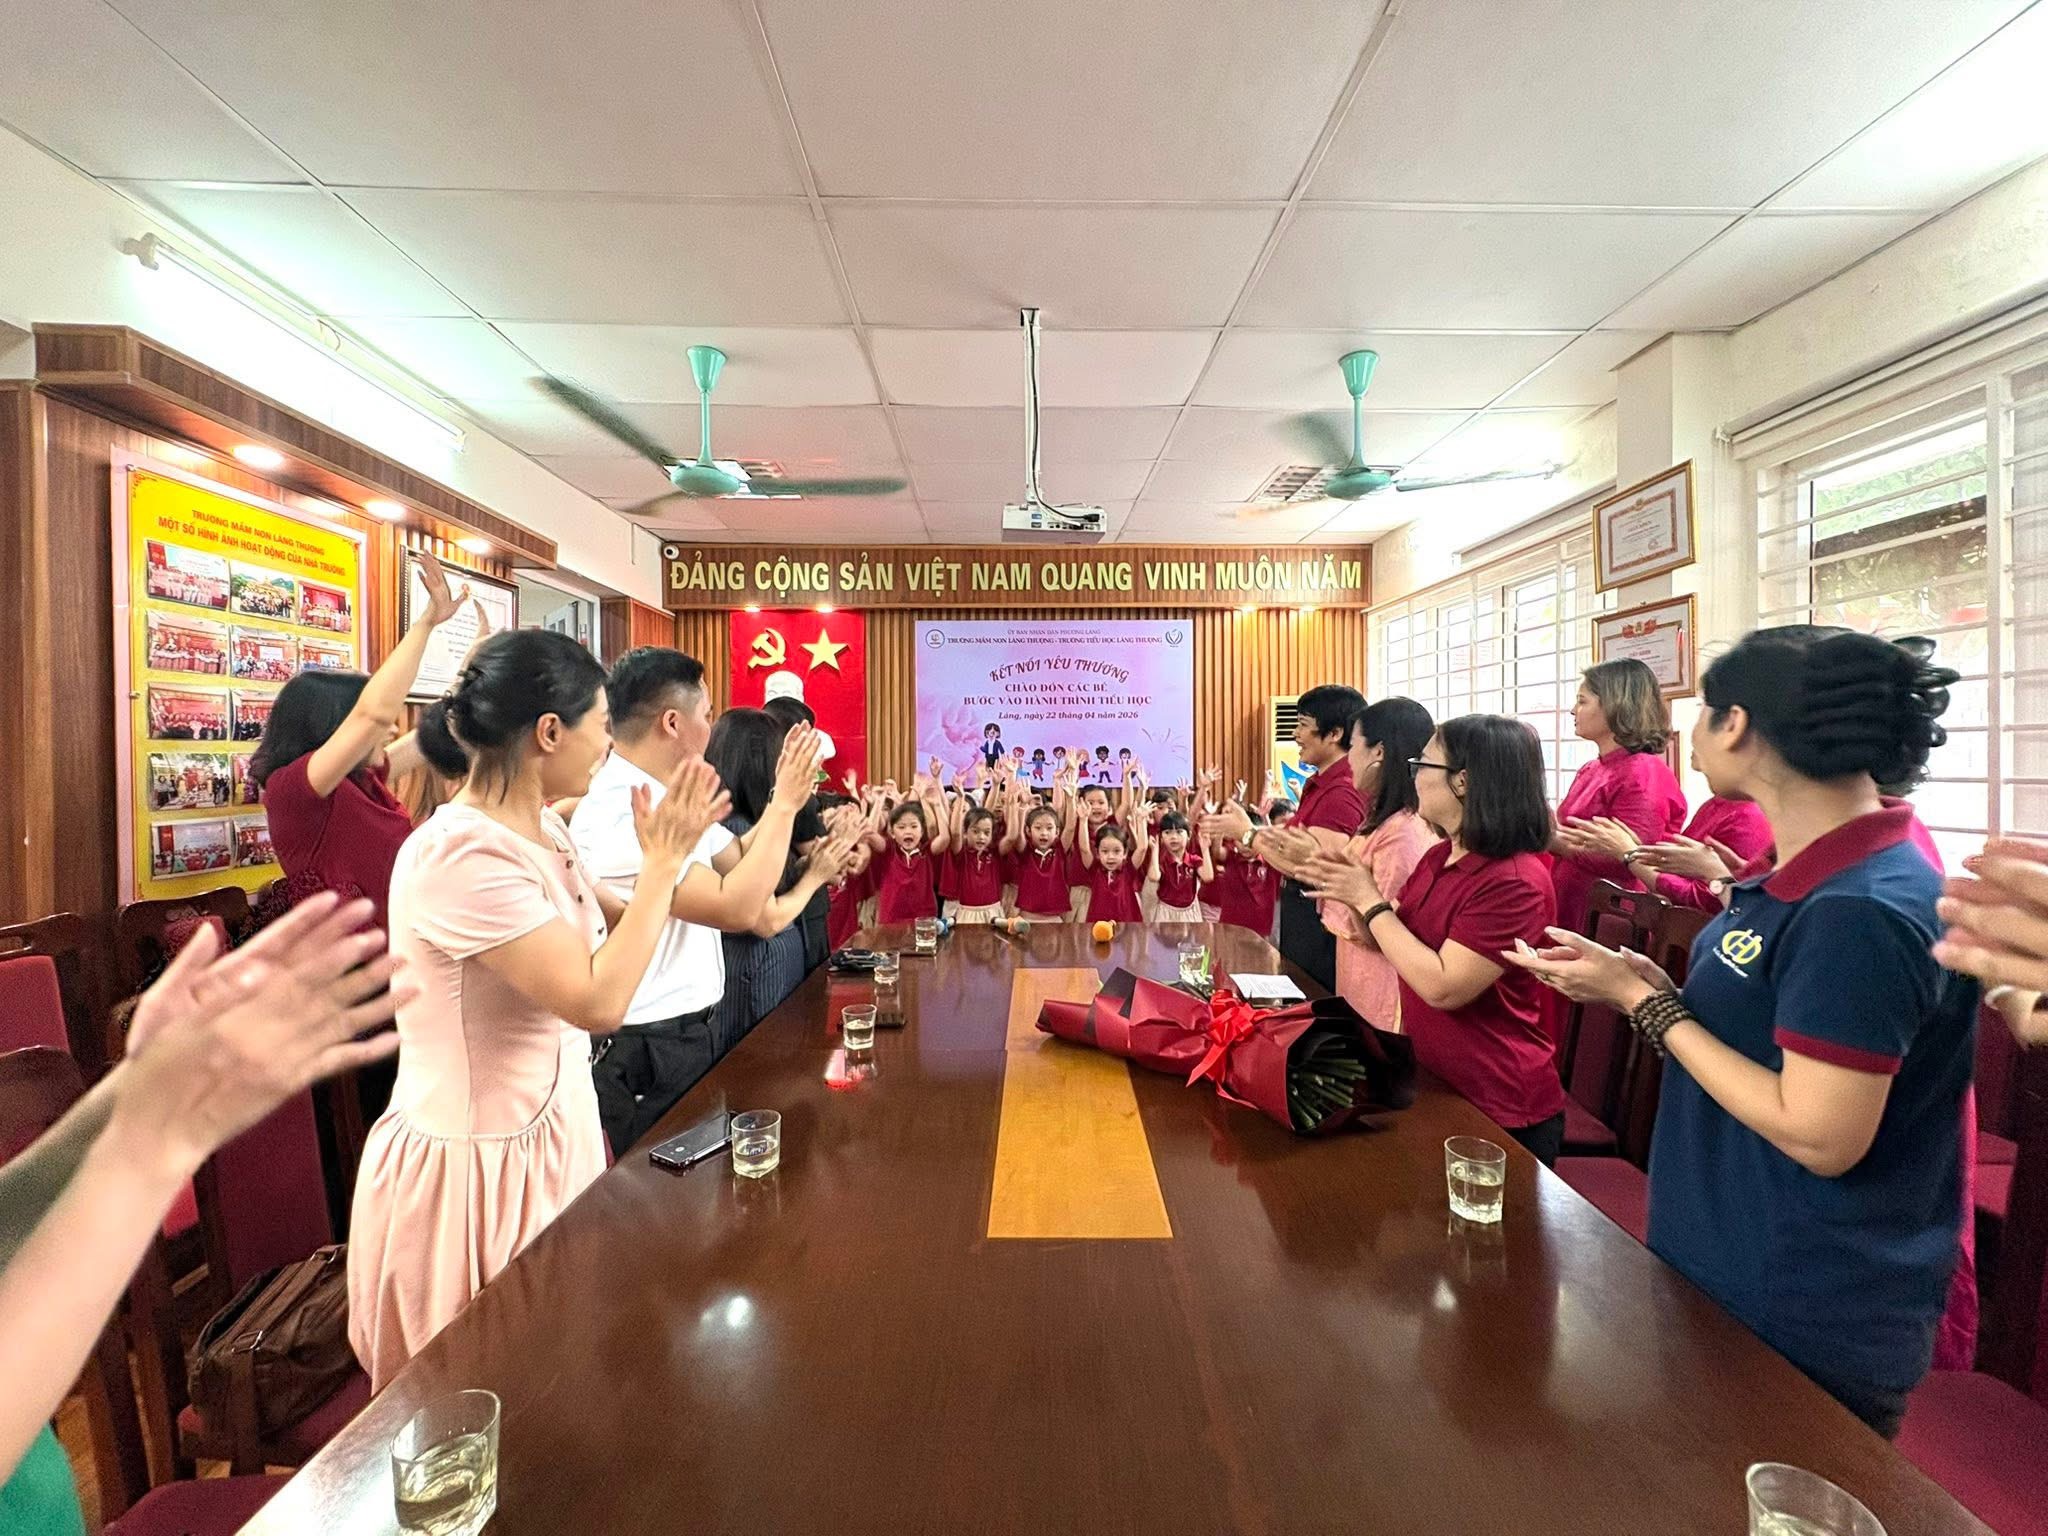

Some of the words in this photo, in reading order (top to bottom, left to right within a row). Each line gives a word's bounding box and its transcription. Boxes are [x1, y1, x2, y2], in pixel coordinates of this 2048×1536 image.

[158, 516, 179, 533] MỘT
[182, 521, 196, 535] SỐ
[263, 545, 286, 560] ĐỘNG
[287, 549, 302, 565] CỦA
[254, 528, 271, 540] NON
[670, 551, 745, 590] ĐẢNG
[754, 556, 830, 598] CỘNG
[839, 552, 894, 591] SẢN
[905, 556, 962, 597] VIỆT
[971, 562, 1031, 591] NAM
[1041, 562, 1133, 591] QUANG
[1144, 562, 1206, 591] VINH
[1215, 555, 1292, 591] MUÔN
[1300, 553, 1361, 590] NĂM
[1101, 637, 1115, 645] HỌC
[989, 661, 1014, 682] KẾT
[1015, 656, 1041, 674] NỐI
[1044, 655, 1072, 670] YÊU
[1074, 658, 1130, 684] THƯƠNG
[1005, 681, 1037, 693] CHÀO
[1040, 681, 1065, 693] ĐÓN
[1067, 681, 1091, 693] CÁC
[1093, 681, 1108, 692] BÉ
[963, 694, 995, 706] BƯỚC
[998, 694, 1022, 706] VÀO
[1025, 694, 1057, 706] HÀNH
[1060, 694, 1095, 705] TRÌNH
[1098, 693, 1125, 705] TIỂU
[1127, 695, 1152, 707] HỌC
[998, 711, 1022, 721] Láng,
[1024, 712, 1044, 721] ngày
[1045, 712, 1057, 720] 22
[1058, 711, 1083, 721] tháng
[1084, 711, 1095, 720] 04
[1097, 711, 1116, 720] năm
[1117, 711, 1139, 720] 2026
